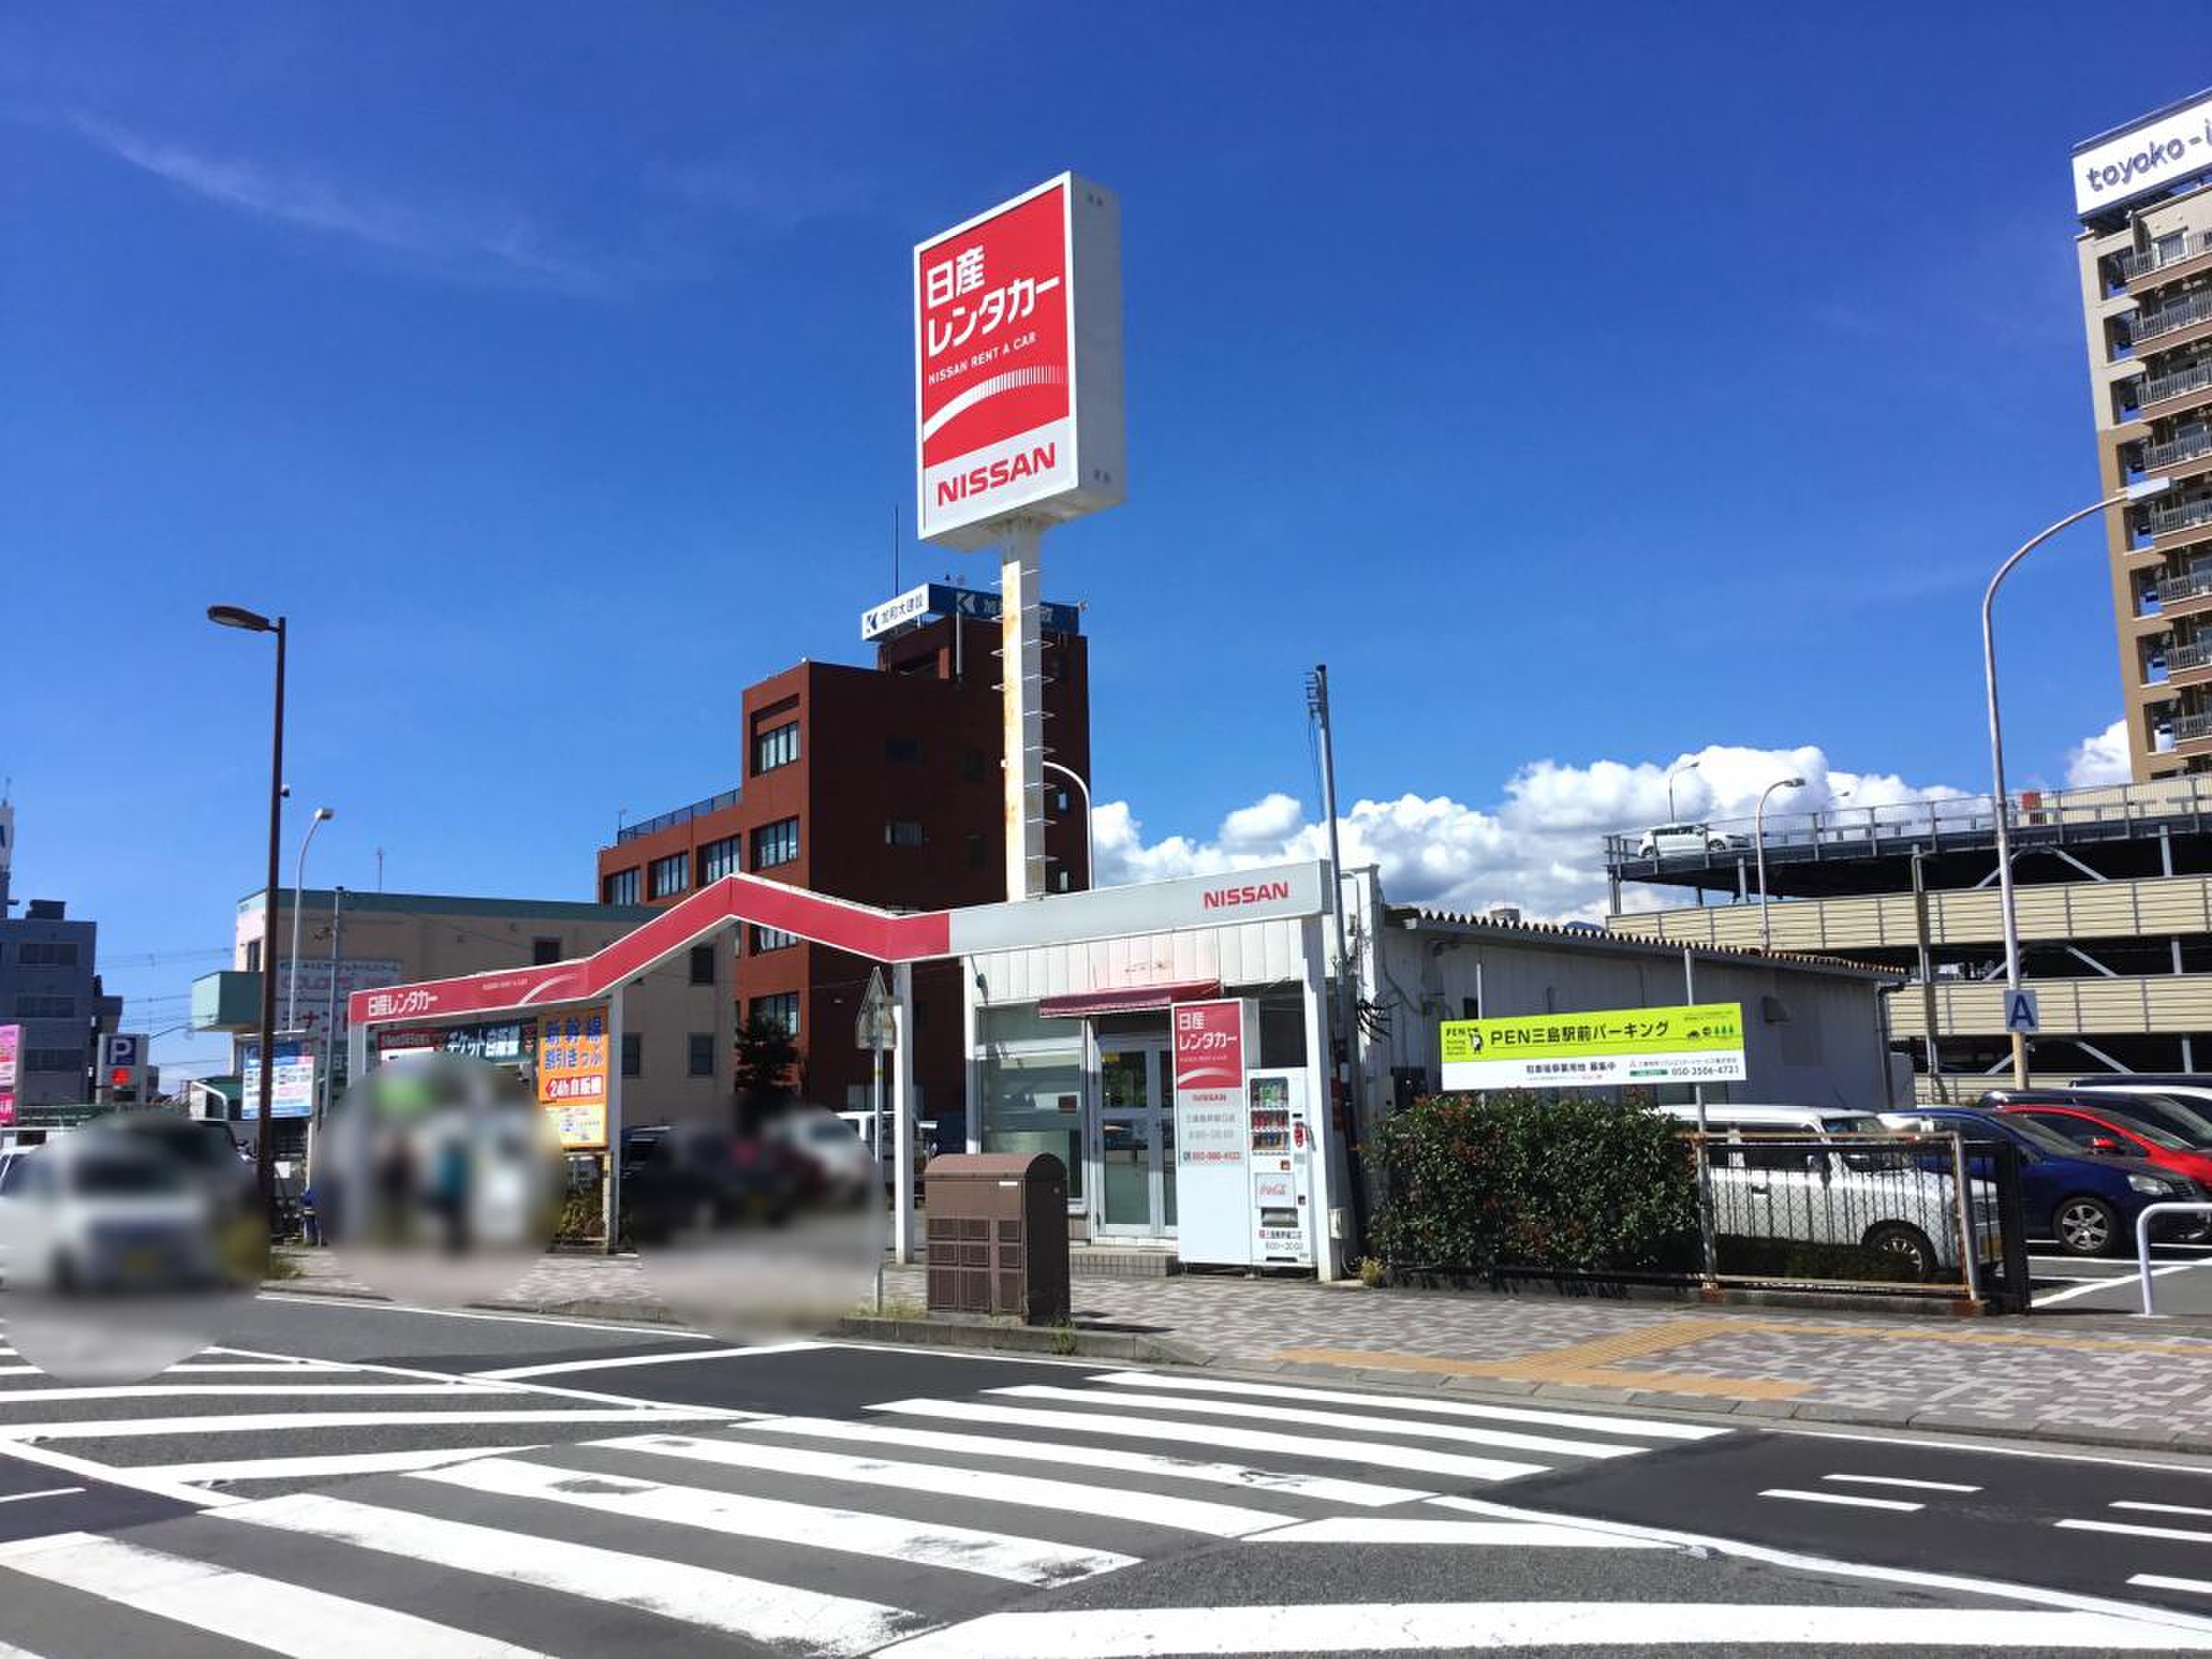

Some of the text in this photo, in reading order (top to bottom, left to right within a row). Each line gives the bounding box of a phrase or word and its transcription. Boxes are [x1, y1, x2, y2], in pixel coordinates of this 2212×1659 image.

[927, 244, 984, 308] 日産
[928, 276, 1060, 358] レンタカー
[928, 332, 1037, 384] NISSAN RENT A CAR
[936, 442, 1056, 507] NISSAN
[1203, 881, 1289, 909] NISSAN
[368, 989, 439, 1018] 日産レンタカー
[2009, 994, 2036, 1028] A
[1180, 1012, 1206, 1030] 日産
[1490, 1020, 1669, 1045] PEN三島駅前パーキング
[110, 1039, 134, 1065] P
[1179, 1032, 1238, 1051] レンタカー
